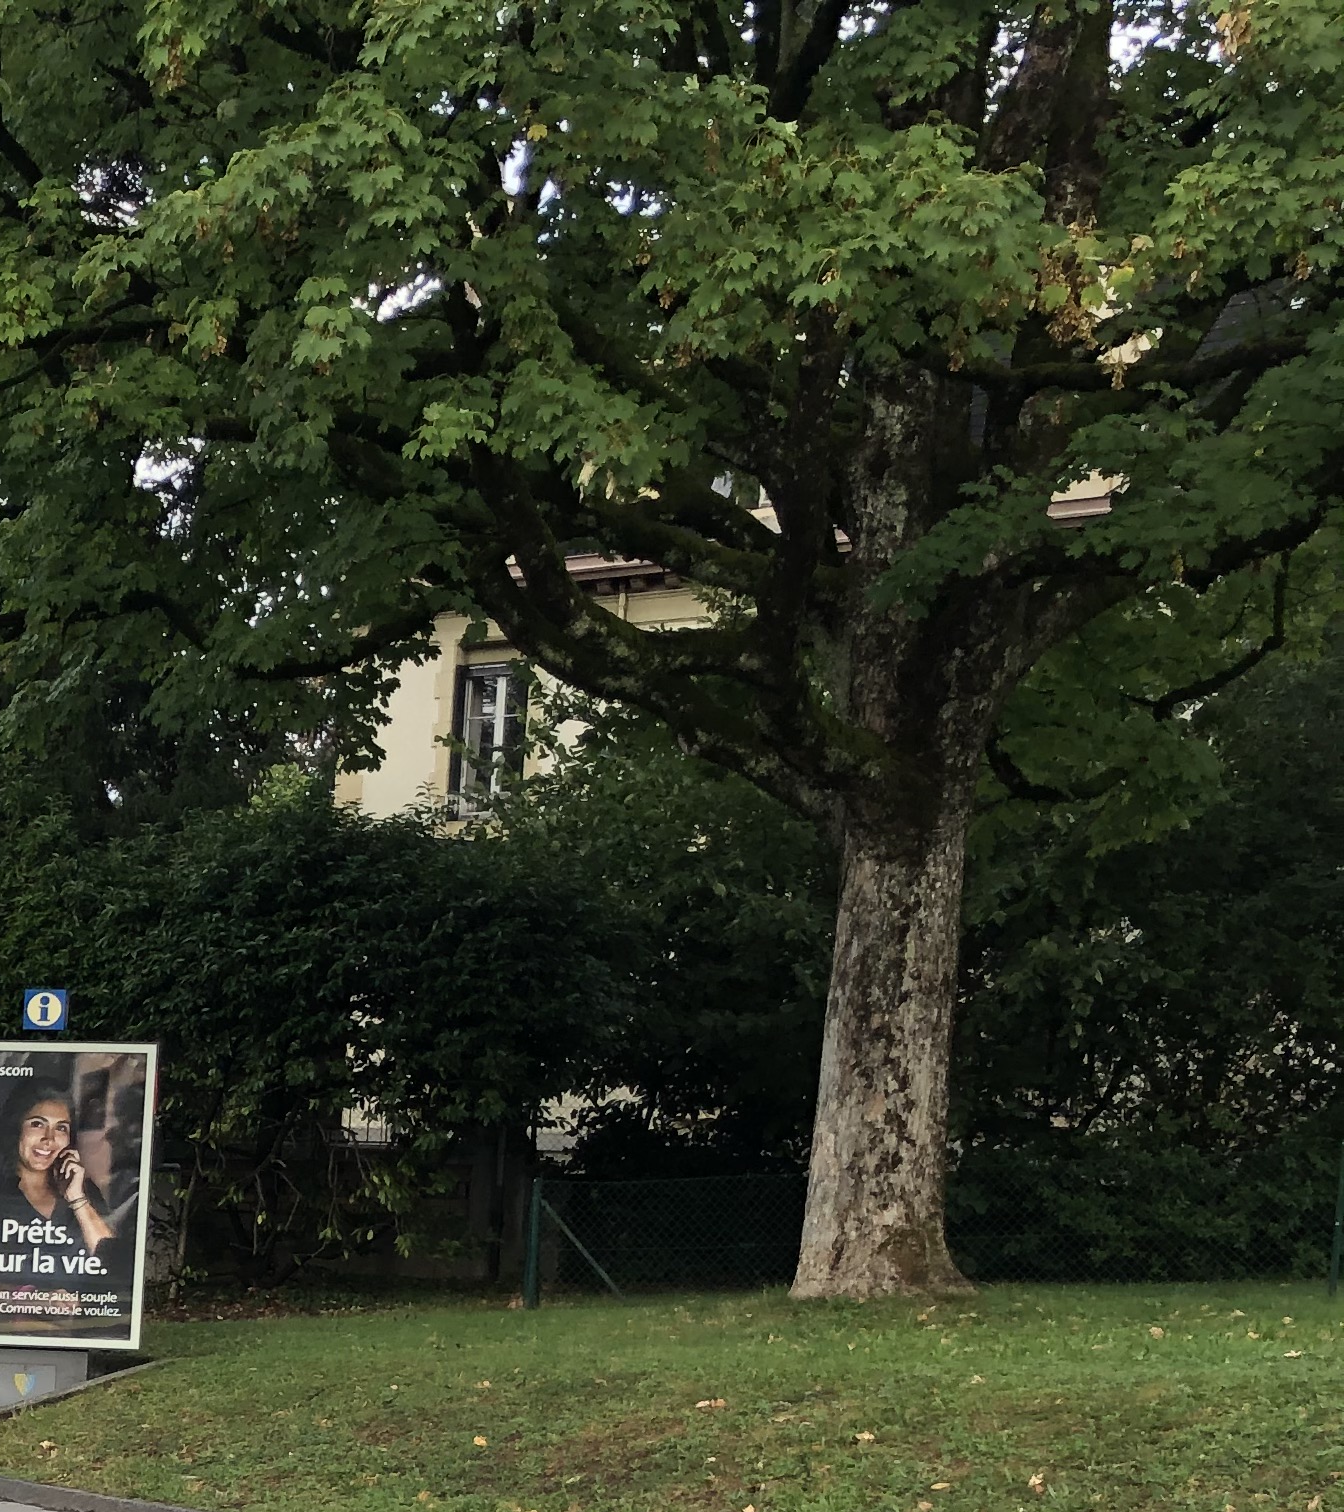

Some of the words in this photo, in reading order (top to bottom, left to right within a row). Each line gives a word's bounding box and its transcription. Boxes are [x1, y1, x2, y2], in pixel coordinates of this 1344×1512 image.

[1, 1217, 75, 1245] Prêts.
[32, 1247, 56, 1274] la
[62, 1248, 109, 1276] vie.
[12, 1289, 50, 1301] service
[51, 1290, 79, 1302] aussi
[80, 1291, 118, 1305] souple
[44, 1305, 70, 1315] vous
[72, 1304, 82, 1316] le
